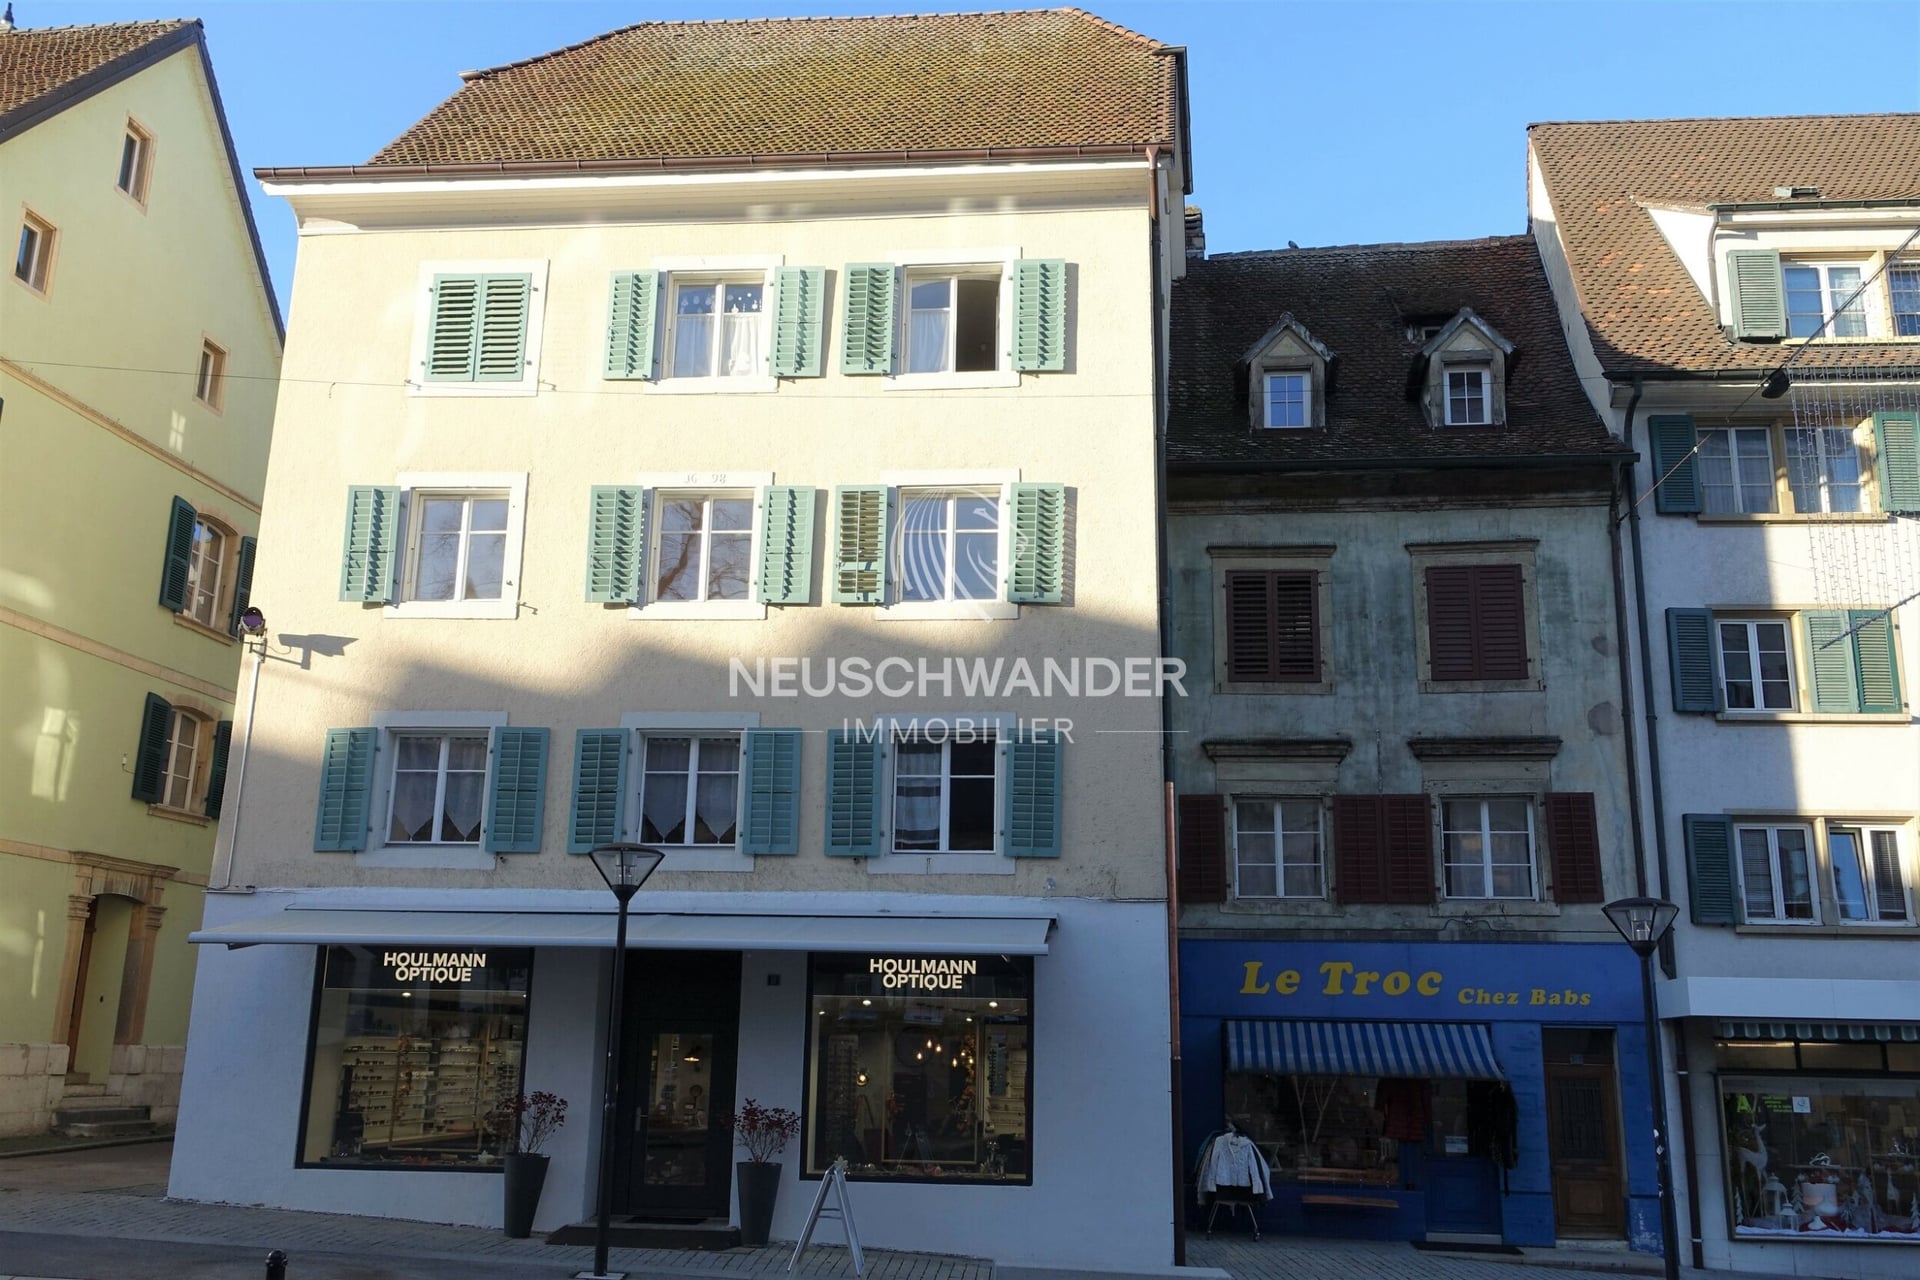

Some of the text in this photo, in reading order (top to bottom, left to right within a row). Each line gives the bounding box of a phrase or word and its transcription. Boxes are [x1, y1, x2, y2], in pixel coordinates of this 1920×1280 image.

[383, 952, 486, 968] HOULMANN
[869, 958, 976, 975] HOULMANN
[395, 966, 472, 983] OPTIQUE
[882, 973, 962, 990] OPTIQUE
[1239, 961, 1443, 997] Le Troc
[1457, 988, 1591, 1006] Chez Babs
